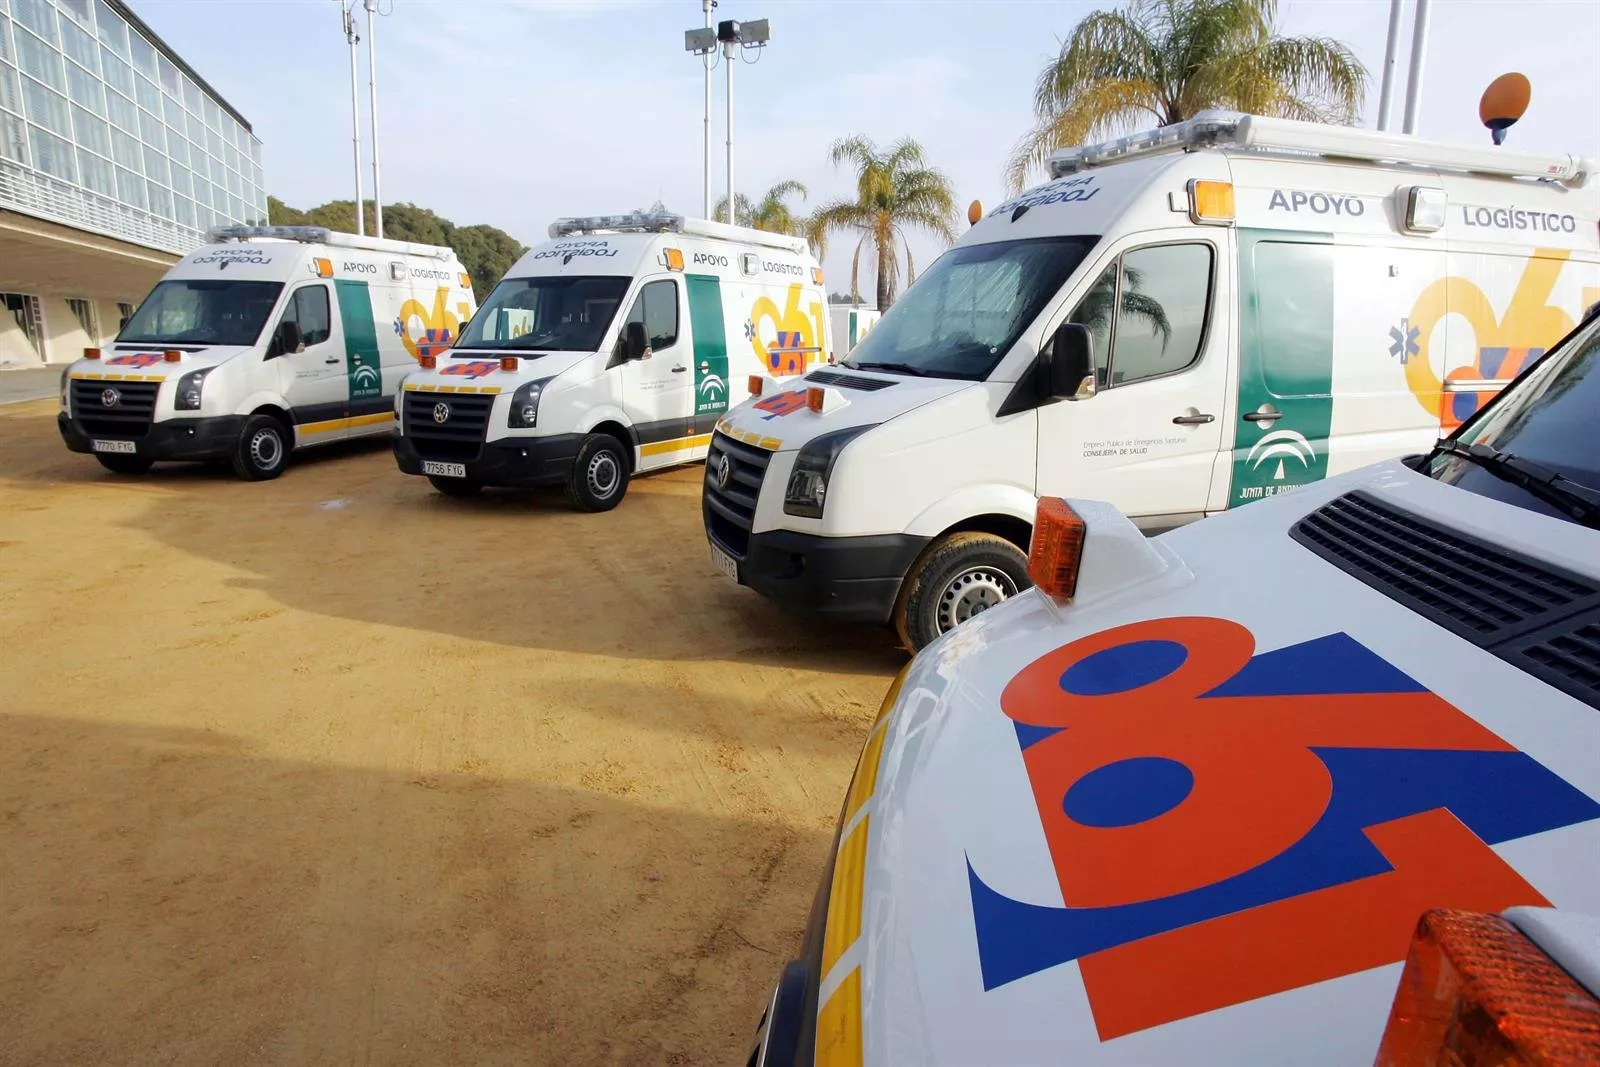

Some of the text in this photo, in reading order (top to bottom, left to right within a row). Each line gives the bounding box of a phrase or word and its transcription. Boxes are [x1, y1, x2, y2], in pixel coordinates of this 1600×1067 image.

[1268, 189, 1576, 233] APOYO LOGÍSTICO
[343, 262, 451, 280] APOYO LOGÍSTICO
[693, 252, 804, 276] APOYO LOGÍSTICO
[1130, 447, 1147, 455] SALUD
[426, 462, 463, 476] 7756 FYG
[1240, 487, 1263, 498] JUNTA
[1265, 486, 1275, 496] DE
